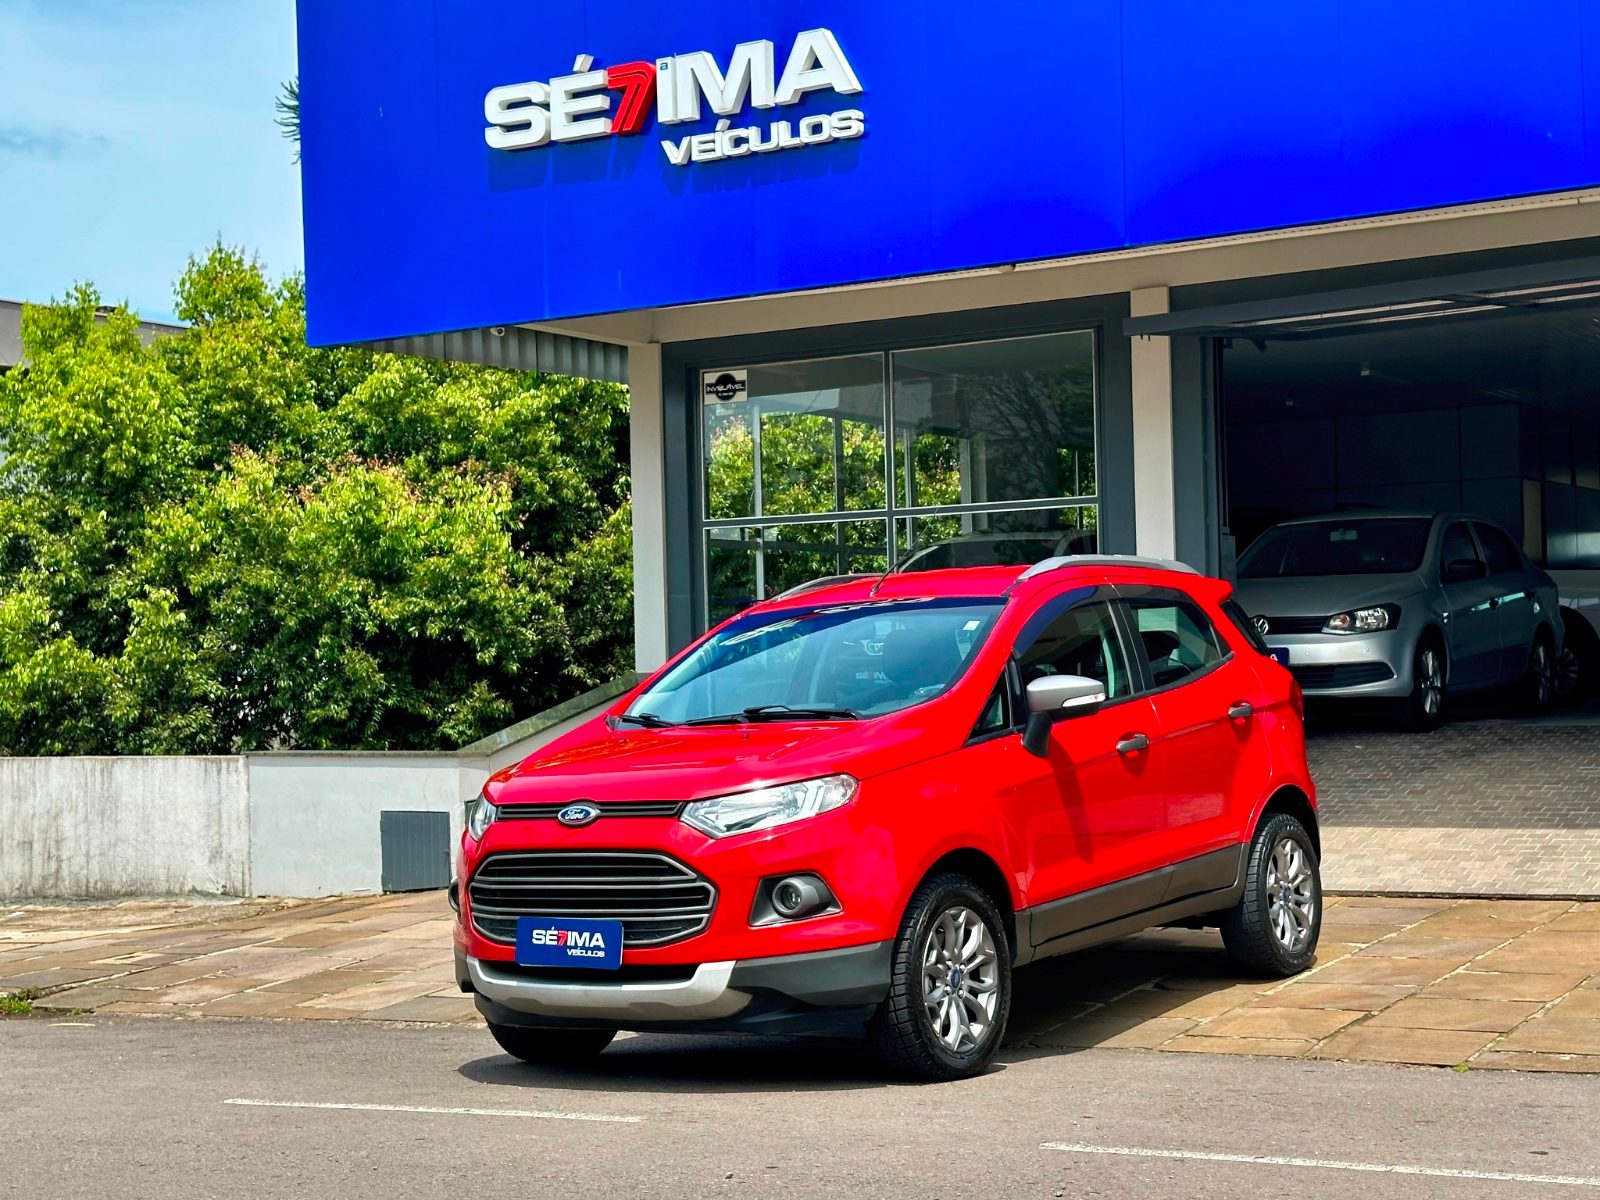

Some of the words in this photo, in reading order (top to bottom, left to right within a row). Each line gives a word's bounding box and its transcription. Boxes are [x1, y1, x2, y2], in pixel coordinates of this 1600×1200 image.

[660, 109, 865, 166] VEÍCULOS
[565, 808, 586, 820] Ford
[566, 947, 605, 958] VEÍCULOS
